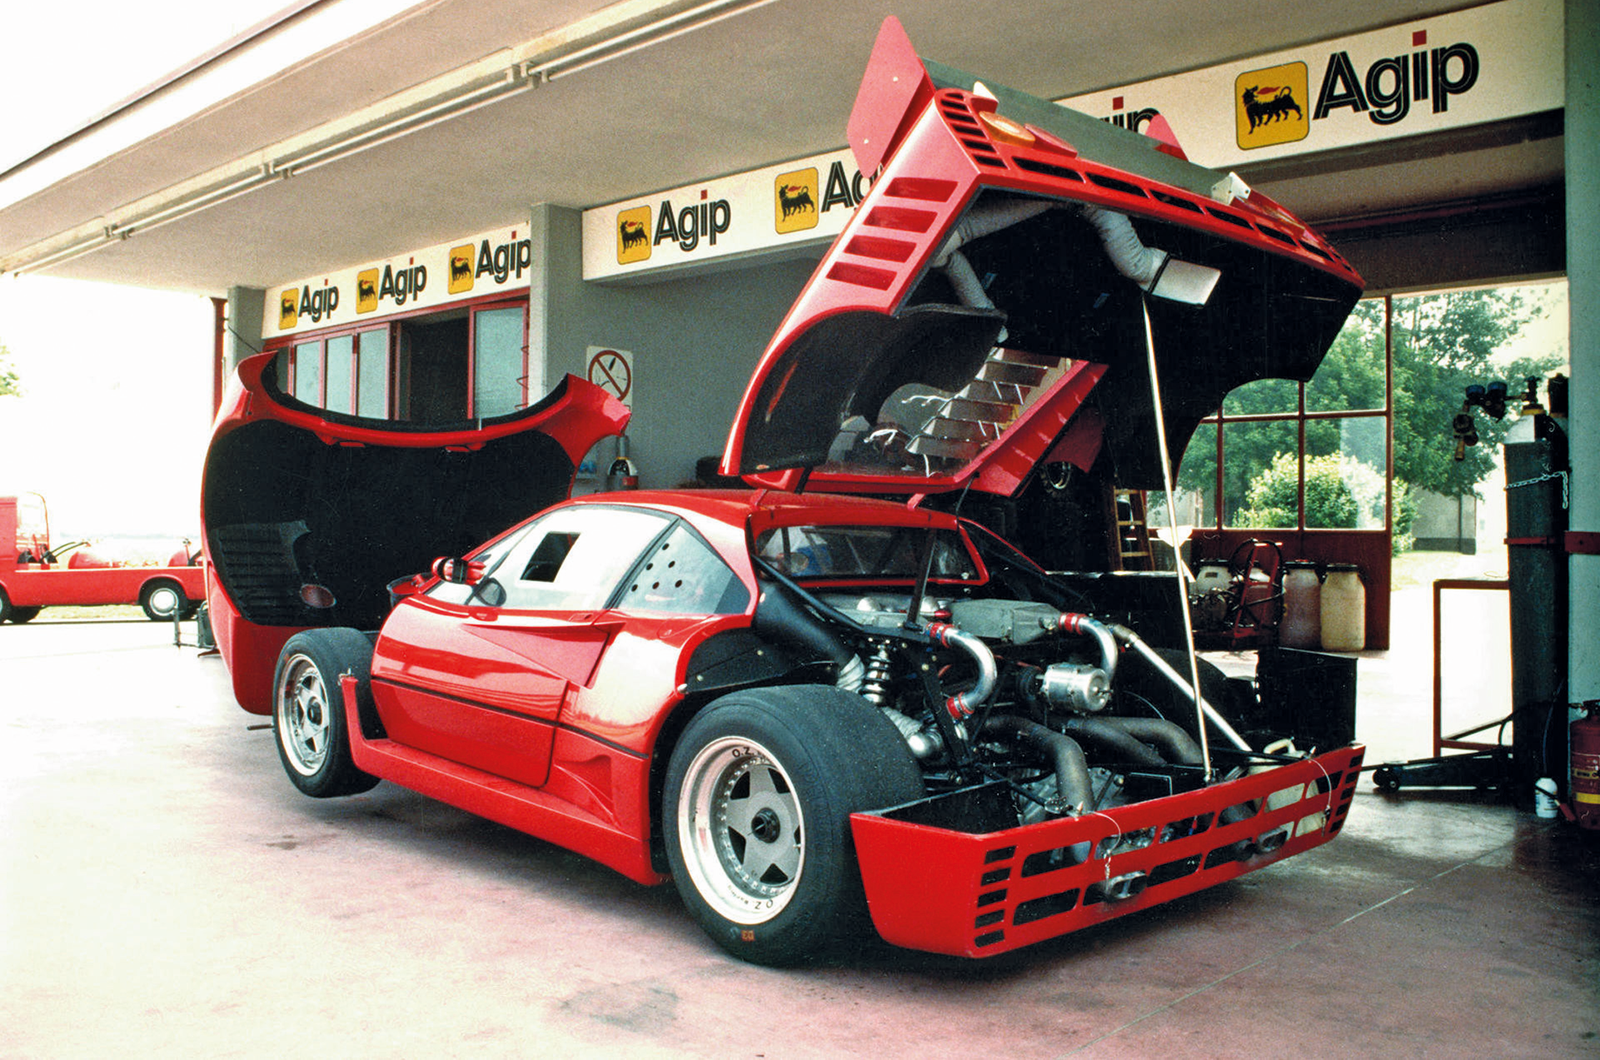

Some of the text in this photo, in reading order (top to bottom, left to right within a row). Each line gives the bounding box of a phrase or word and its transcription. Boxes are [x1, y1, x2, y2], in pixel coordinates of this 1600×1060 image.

[1312, 30, 1480, 125] Agip
[653, 189, 731, 252] Agip
[379, 257, 427, 305] Agip
[475, 231, 531, 284] Agip
[298, 279, 339, 323] Agip
